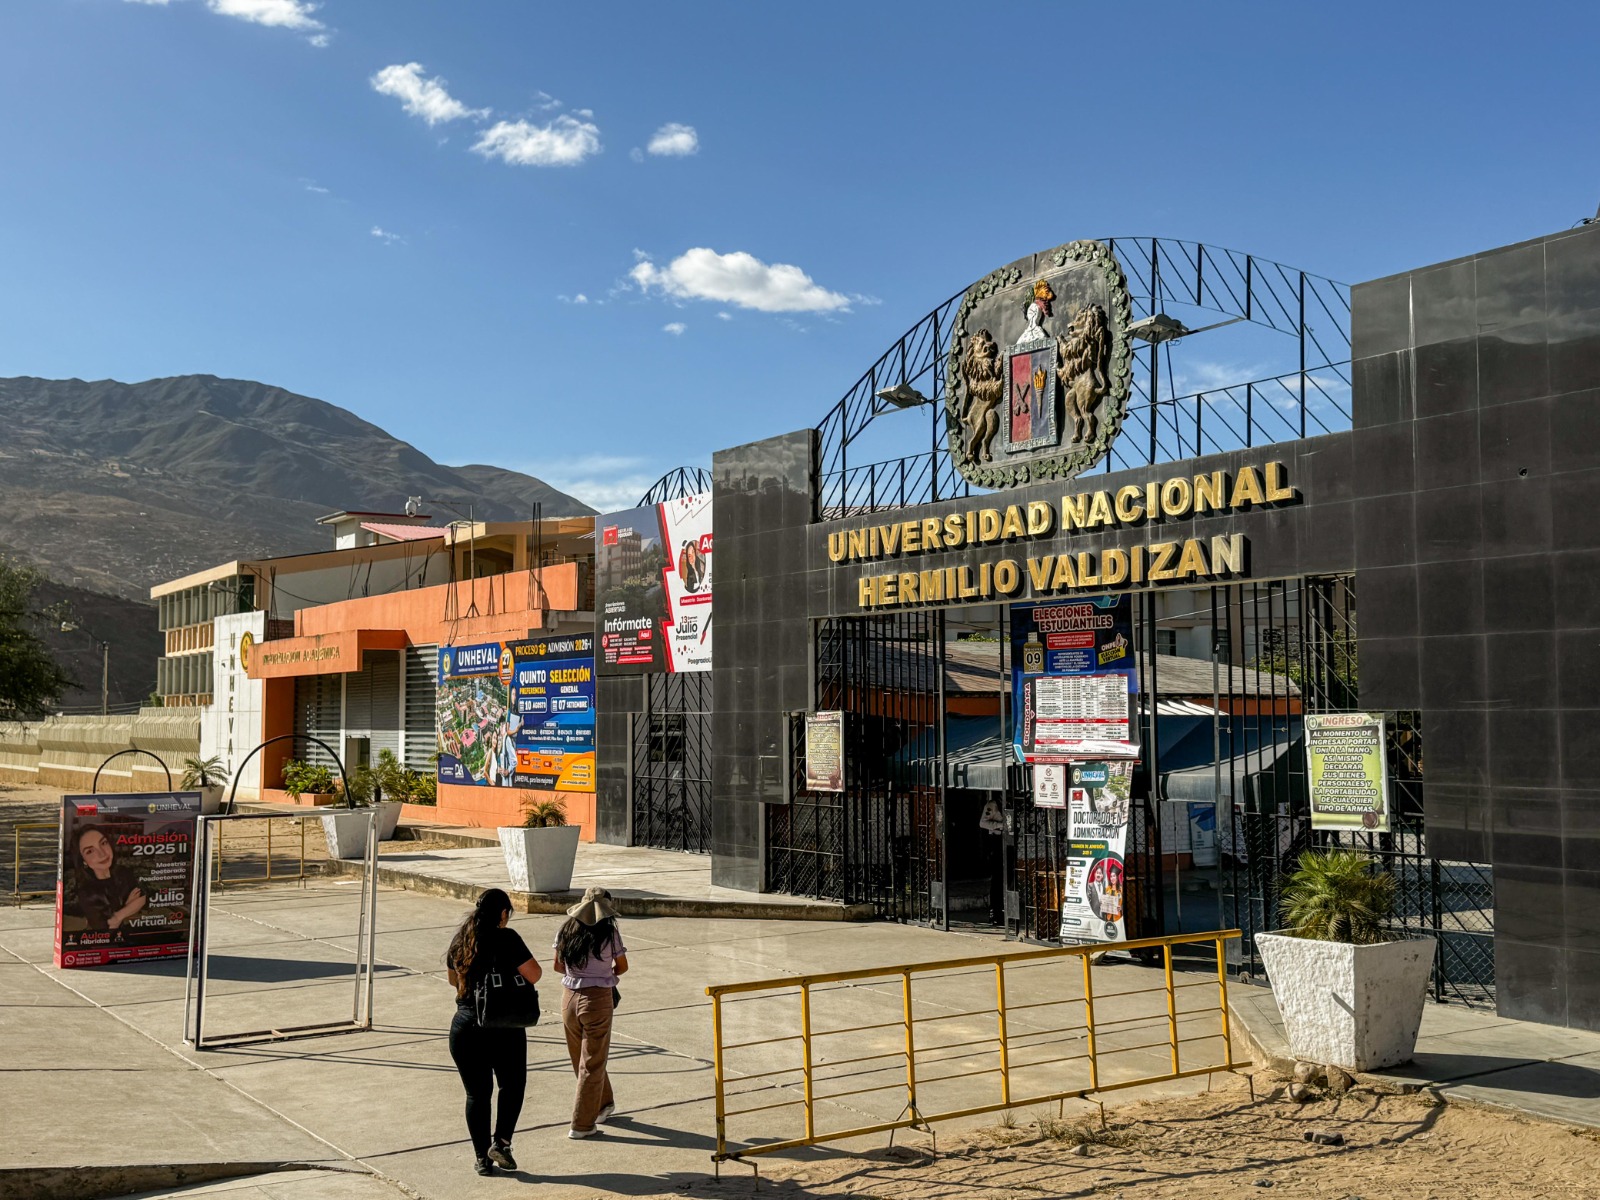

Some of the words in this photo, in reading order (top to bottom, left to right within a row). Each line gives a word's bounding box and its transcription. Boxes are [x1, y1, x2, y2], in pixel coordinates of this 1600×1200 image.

[828, 501, 1053, 562] UNIVERSIDAD
[1061, 462, 1295, 530] NACIONAL
[858, 558, 1021, 607] HERMILIO
[1026, 533, 1246, 592] VALDIZAN
[1033, 605, 1093, 621] ELECCIONES
[604, 616, 652, 632] Infórmate
[681, 616, 688, 624] 13
[1039, 615, 1113, 632] ESTUDIANTILES
[676, 621, 698, 634] Julio
[515, 644, 538, 656] PROCESO
[547, 639, 574, 653] ADMISIÓN
[458, 647, 498, 666] UNHEVAL
[1026, 652, 1041, 665] 09
[519, 670, 547, 686] QUINTO
[550, 665, 591, 683] SELECCIÓN
[560, 685, 579, 694] GENERAL
[227, 632, 236, 776] UNHEVAL
[525, 700, 531, 710] 10
[559, 700, 566, 710] 07
[1322, 716, 1363, 726] INGRESO
[1347, 747, 1372, 755] MANO,
[1325, 788, 1377, 796] PORTABILIDAD
[1332, 796, 1374, 804] CUALQUIER
[156, 803, 192, 811] UNHEVAL
[1073, 811, 1110, 825] DOCTORADO
[1113, 811, 1123, 825] EN
[116, 831, 188, 845] Admisión
[132, 844, 175, 856] 2025
[150, 867, 186, 875] Doctorado
[138, 874, 186, 882] Posdoctorado
[149, 891, 184, 902] Julio
[169, 911, 184, 920] 20
[129, 917, 167, 928] Virtual
[81, 931, 110, 940] Aulas
